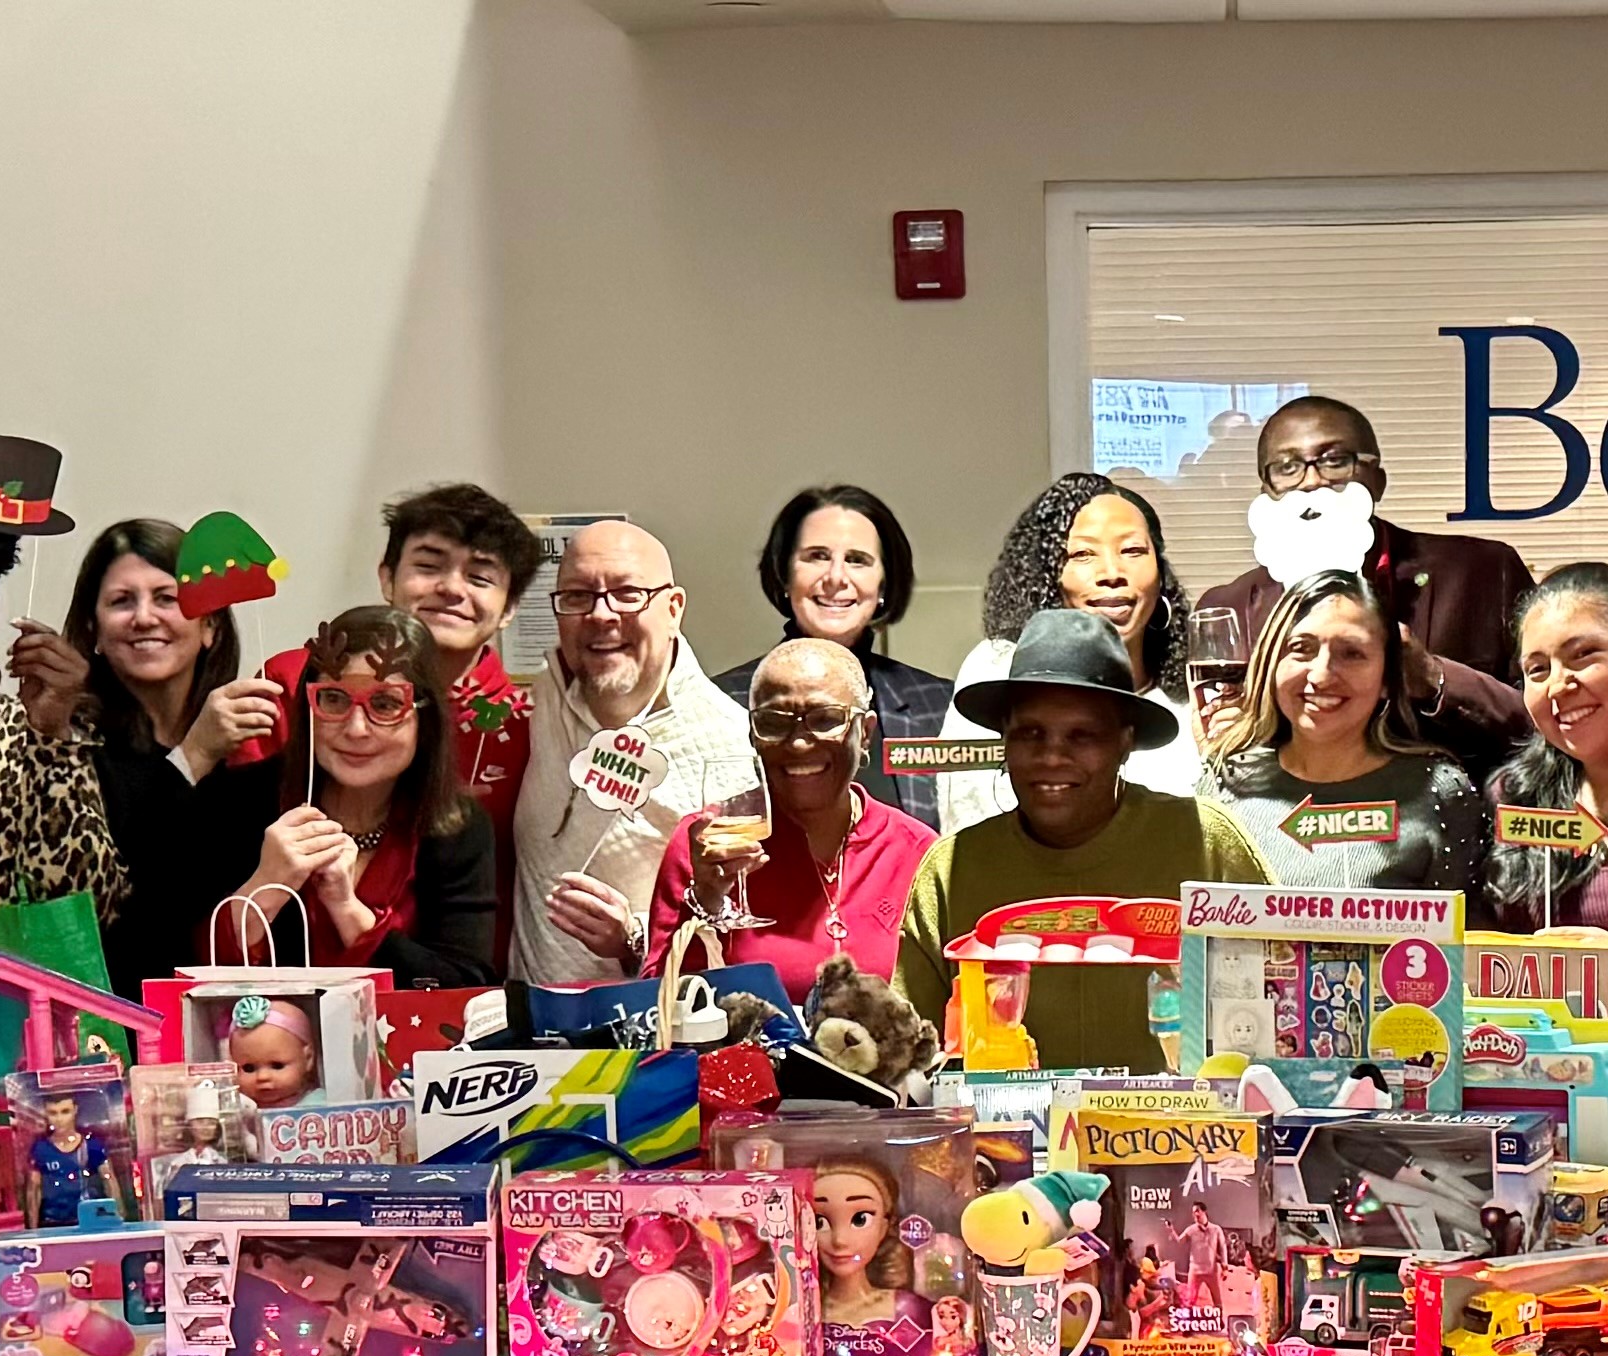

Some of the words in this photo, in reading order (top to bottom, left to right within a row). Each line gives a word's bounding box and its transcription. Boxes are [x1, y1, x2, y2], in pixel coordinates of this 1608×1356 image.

[614, 733, 646, 759] OH
[889, 745, 1006, 765] #NAUGHTIE
[592, 747, 650, 784] WHAT
[584, 768, 640, 805] FUN!!
[1295, 809, 1388, 837] #NICER
[1508, 816, 1583, 840] #NICE
[1137, 906, 1175, 920] FOOD
[1186, 888, 1258, 927] Barbie
[1264, 894, 1334, 918] SUPER
[1341, 897, 1449, 923] ACTIVITY
[1405, 945, 1427, 979] 3
[421, 1063, 537, 1115] NERF
[1089, 1095, 1130, 1109] HOW
[1136, 1095, 1157, 1108] TO
[1160, 1095, 1210, 1109] DRAW
[270, 1105, 407, 1152] CANDY
[1085, 1122, 1246, 1158] PICTIONARY
[510, 1190, 622, 1212] KITCHEN
[1130, 1185, 1172, 1201] Draw
[511, 1213, 543, 1227] AND
[551, 1213, 583, 1227] TEA
[589, 1212, 623, 1227] SET
[1168, 1305, 1191, 1318] See
[1203, 1305, 1221, 1318] On
[1517, 1301, 1537, 1322] 10
[1169, 1318, 1222, 1332] Screen!
